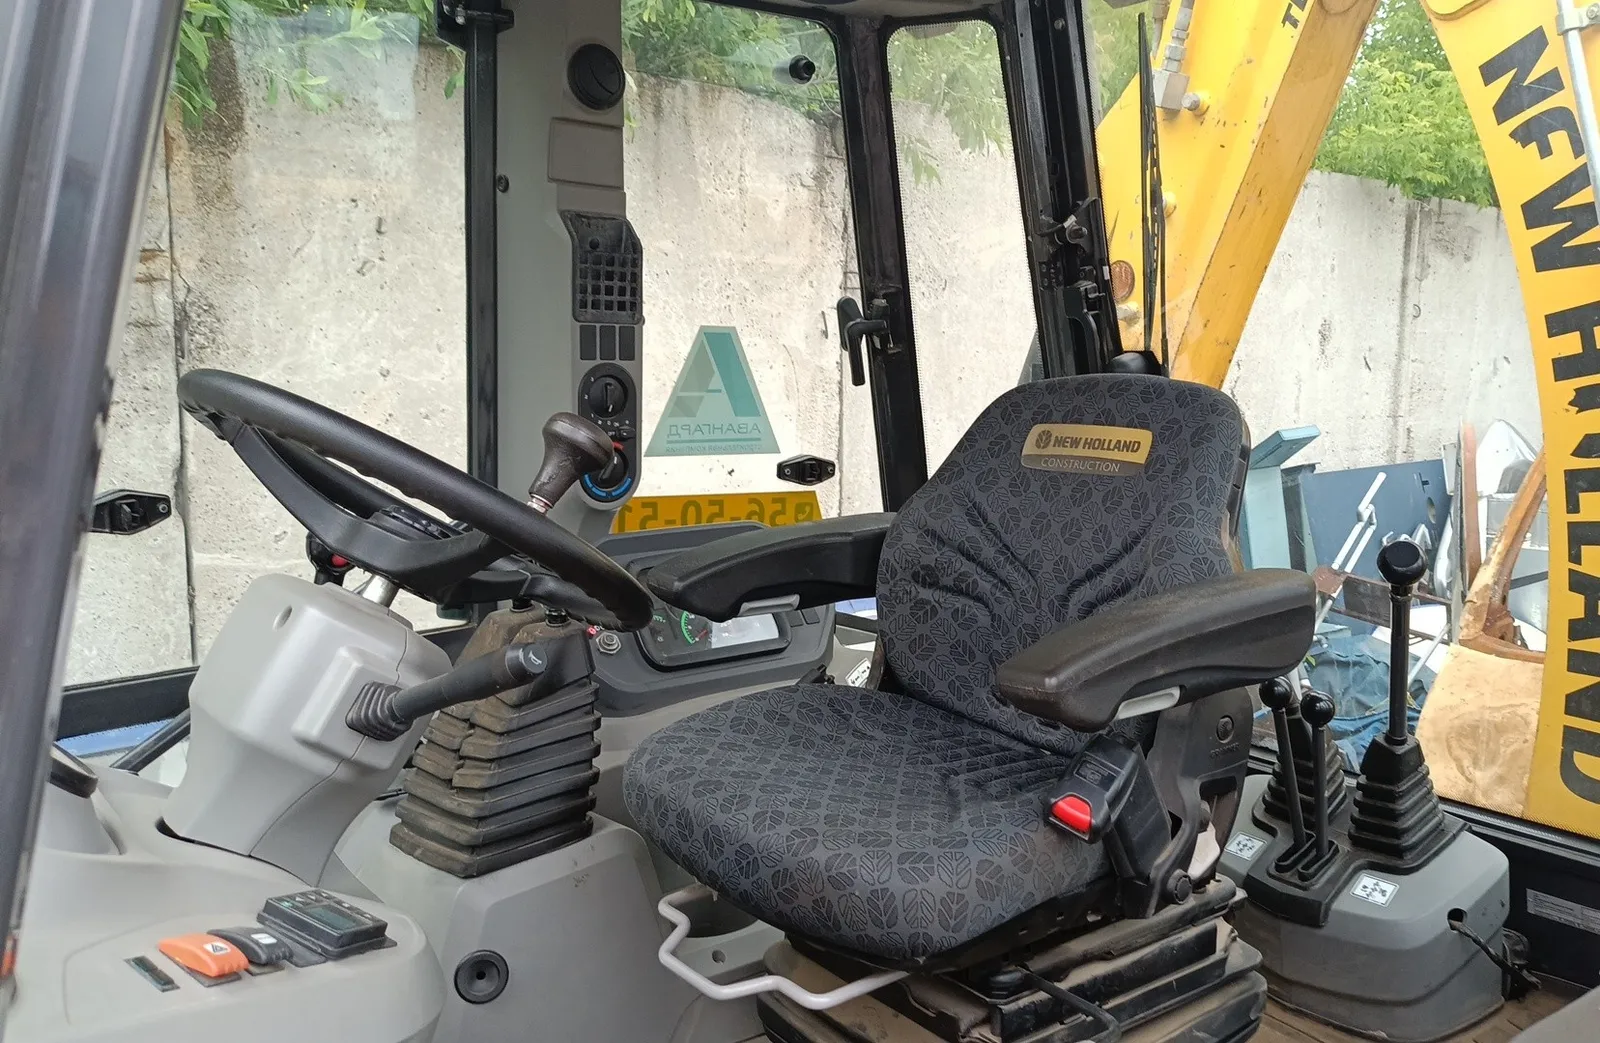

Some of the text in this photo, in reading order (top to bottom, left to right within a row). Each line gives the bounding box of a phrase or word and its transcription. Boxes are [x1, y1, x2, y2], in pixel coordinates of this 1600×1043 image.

[1052, 436, 1141, 453] NEW HOLLAND
[1041, 457, 1120, 472] CONSTRUCTION
